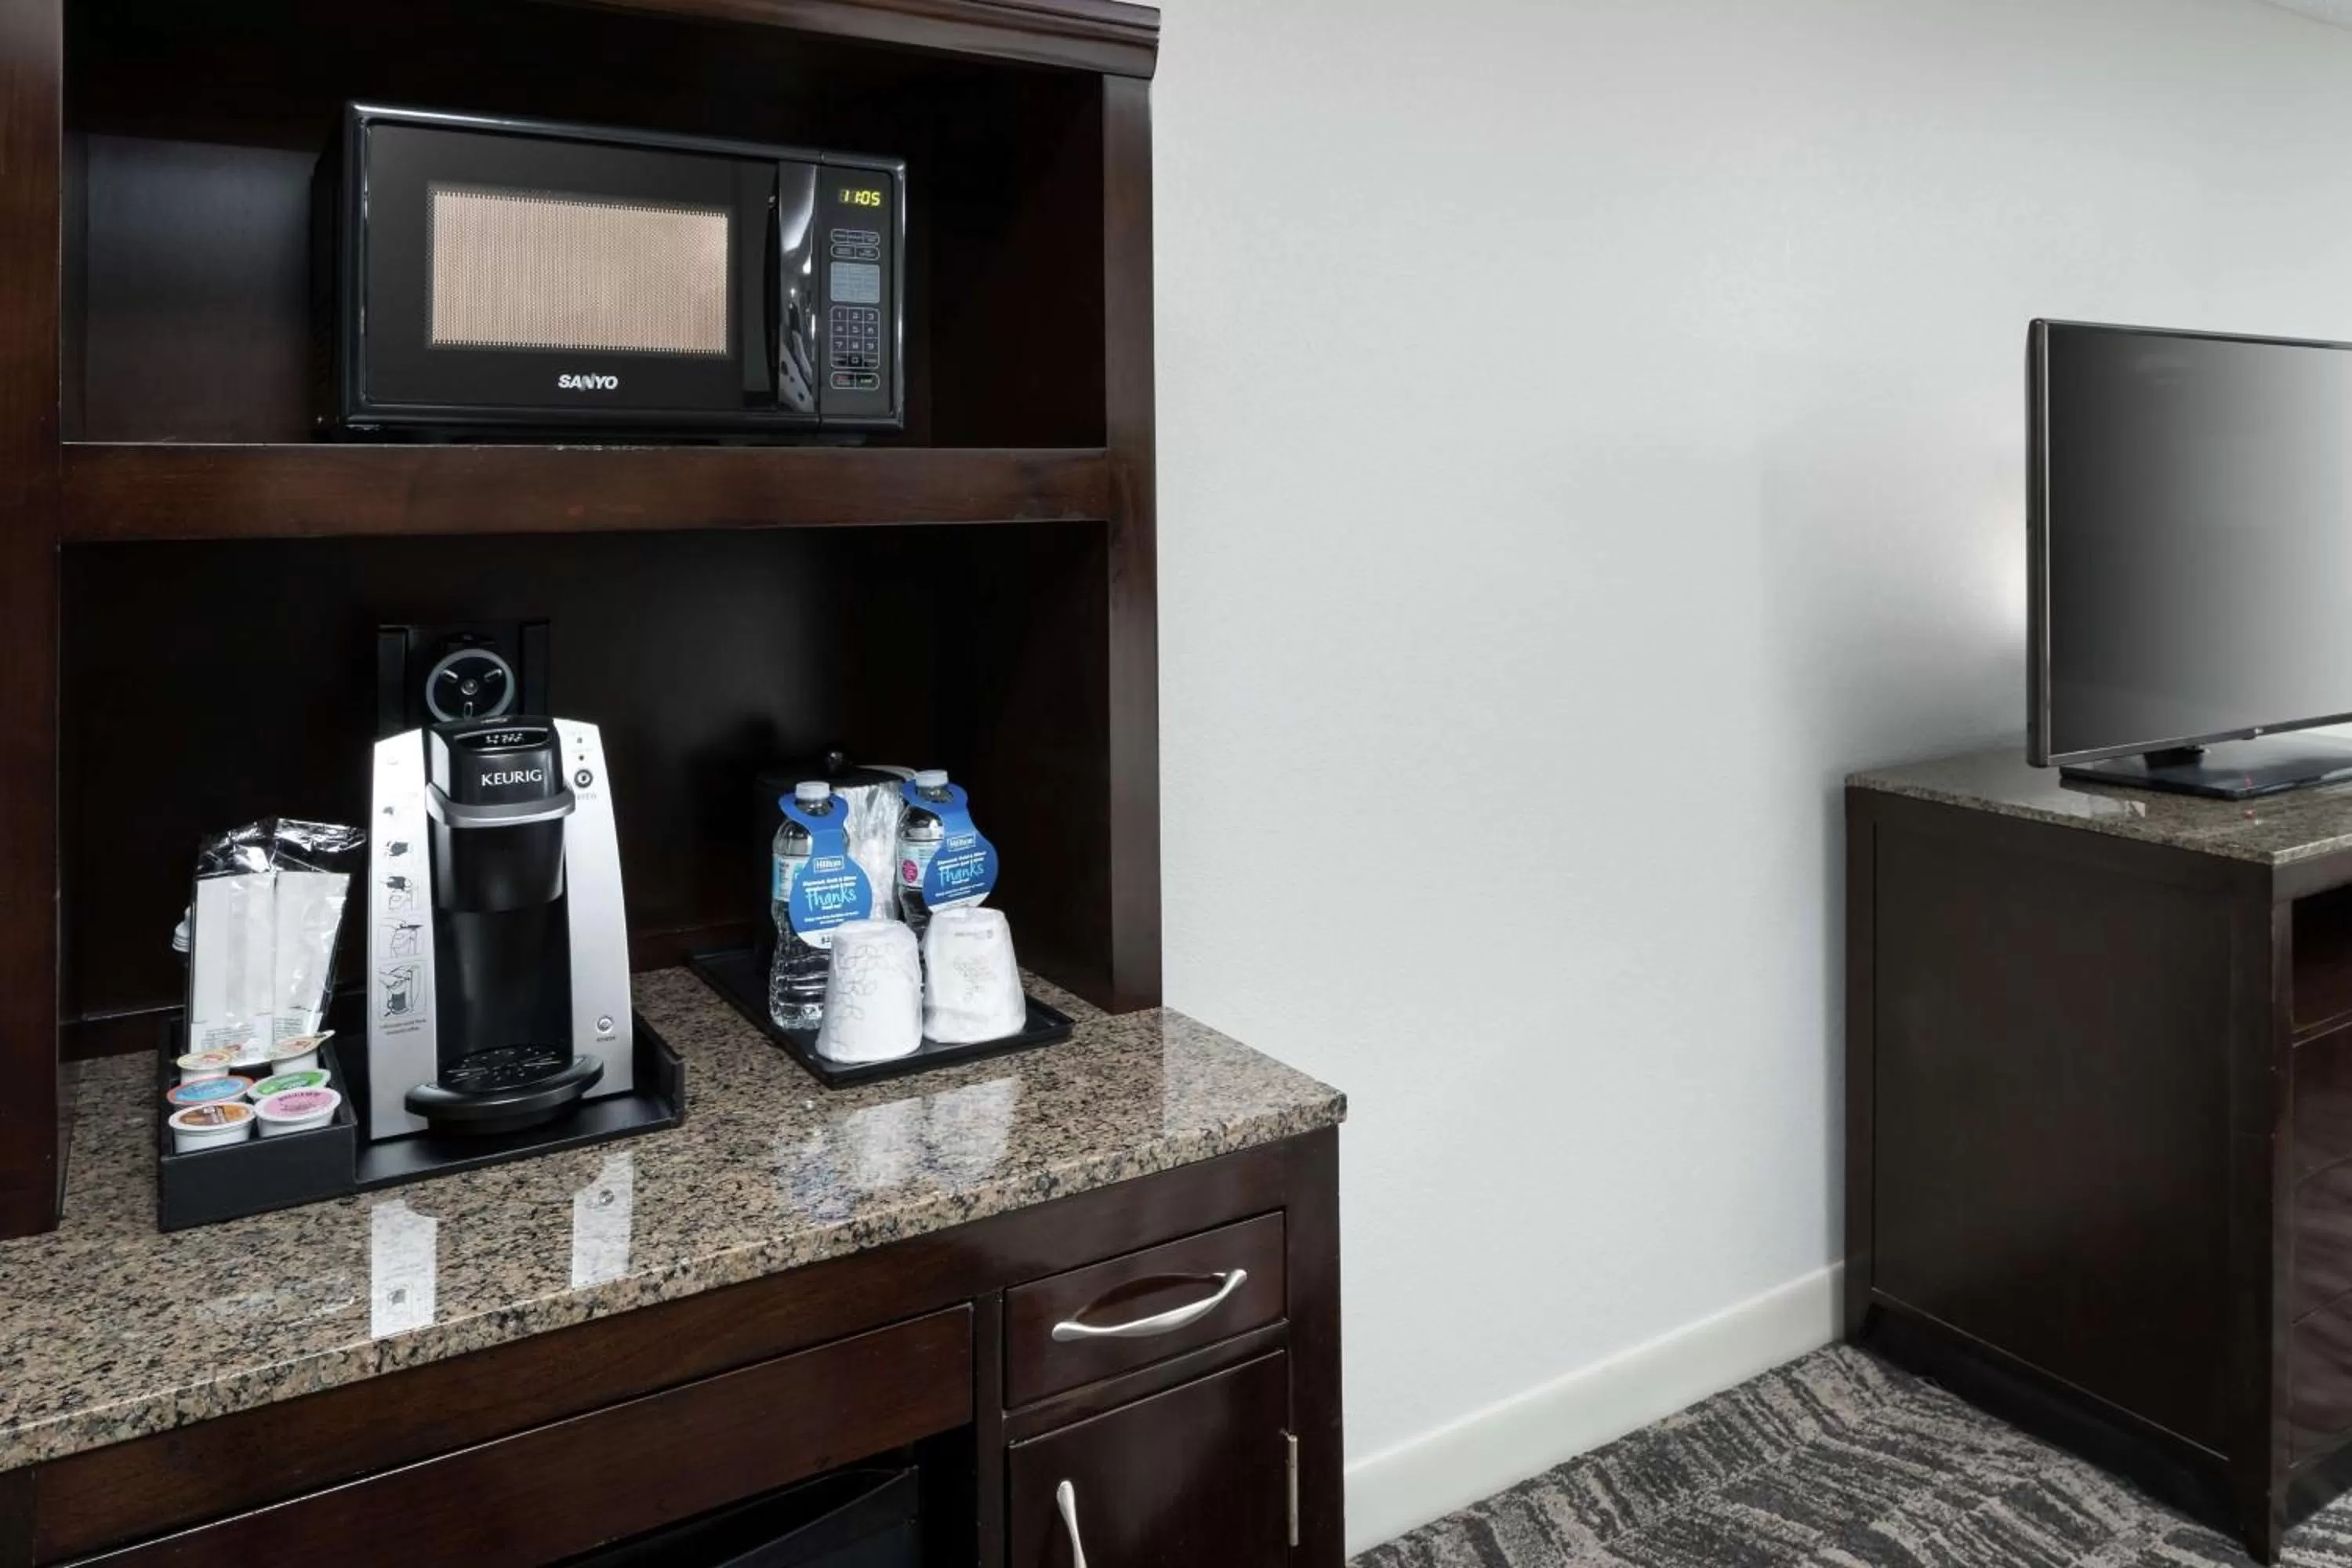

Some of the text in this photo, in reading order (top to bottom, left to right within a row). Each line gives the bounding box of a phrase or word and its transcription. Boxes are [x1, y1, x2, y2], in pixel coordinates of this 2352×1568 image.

[557, 372, 619, 391] SANYO
[481, 769, 543, 786] KEURIG
[816, 859, 841, 870] Hilton
[938, 860, 985, 887] Thanks
[805, 883, 857, 913] Thanks
